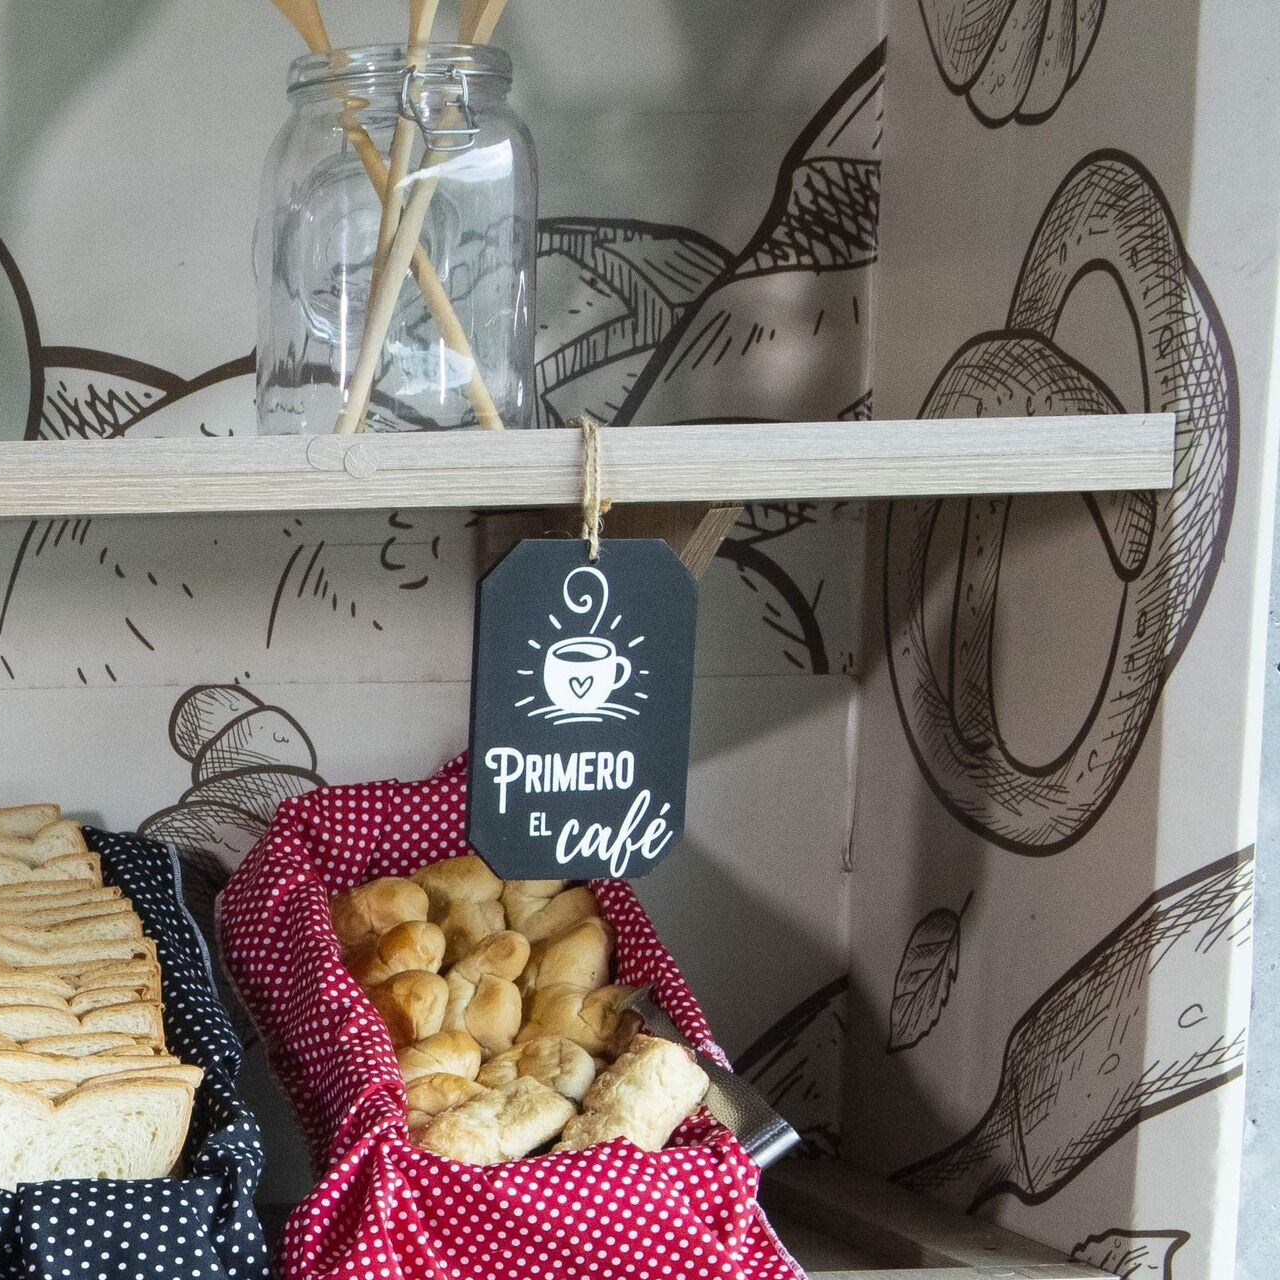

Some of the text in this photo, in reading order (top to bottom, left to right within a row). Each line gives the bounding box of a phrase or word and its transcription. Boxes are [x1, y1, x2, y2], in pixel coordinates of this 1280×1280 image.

[484, 746, 635, 814] PRIMERO
[529, 789, 673, 878] EL café
